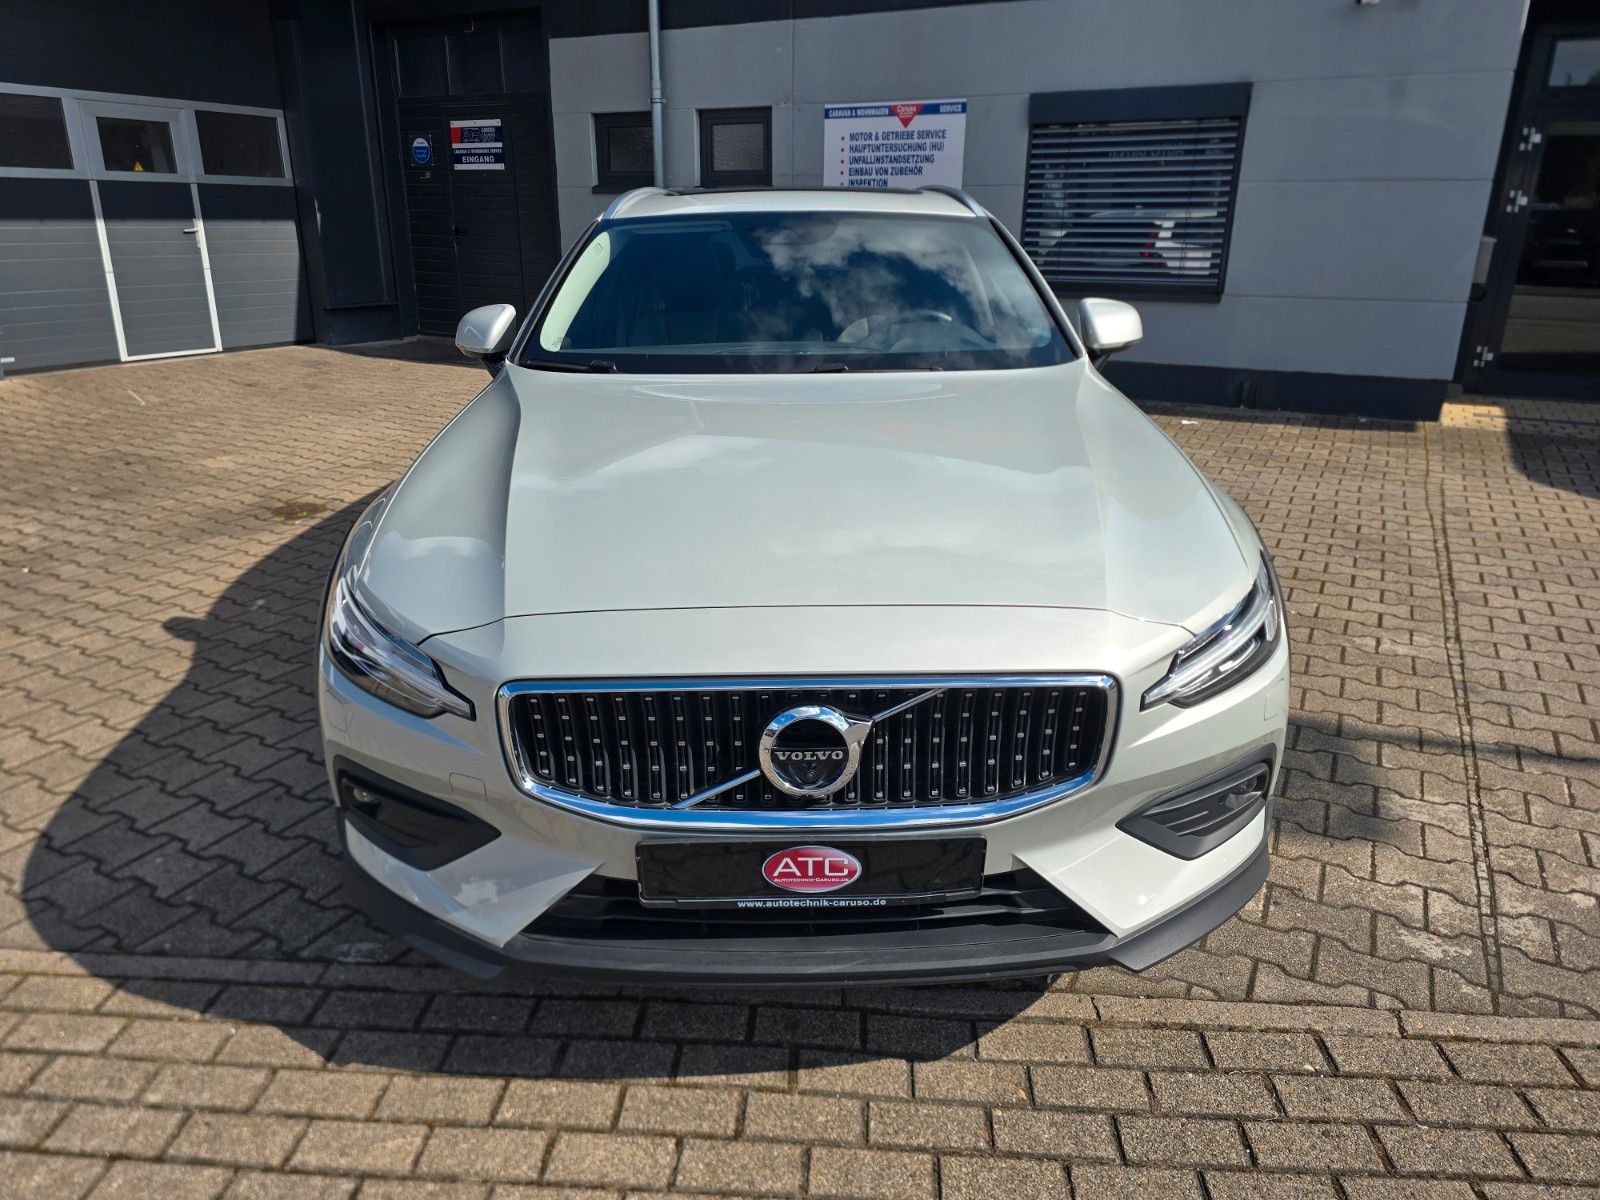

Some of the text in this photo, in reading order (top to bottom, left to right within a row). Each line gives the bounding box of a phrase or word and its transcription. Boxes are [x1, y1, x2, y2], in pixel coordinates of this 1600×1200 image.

[940, 104, 962, 112] SERVICE
[849, 130, 947, 141] MOTOR & GETRIEBE SERVICE
[849, 142, 944, 153] HAUPTUNTERSUCHUNG (HU)
[462, 155, 494, 163] EINGANG
[848, 154, 935, 165] UNFALLINSTANDSETZUNG
[848, 165, 923, 176] EINBAU VON ZUBEHÖR
[775, 751, 844, 760] VOLVO
[772, 857, 849, 876] ATC
[737, 899, 887, 908] www.autotechnik-caruso.de
